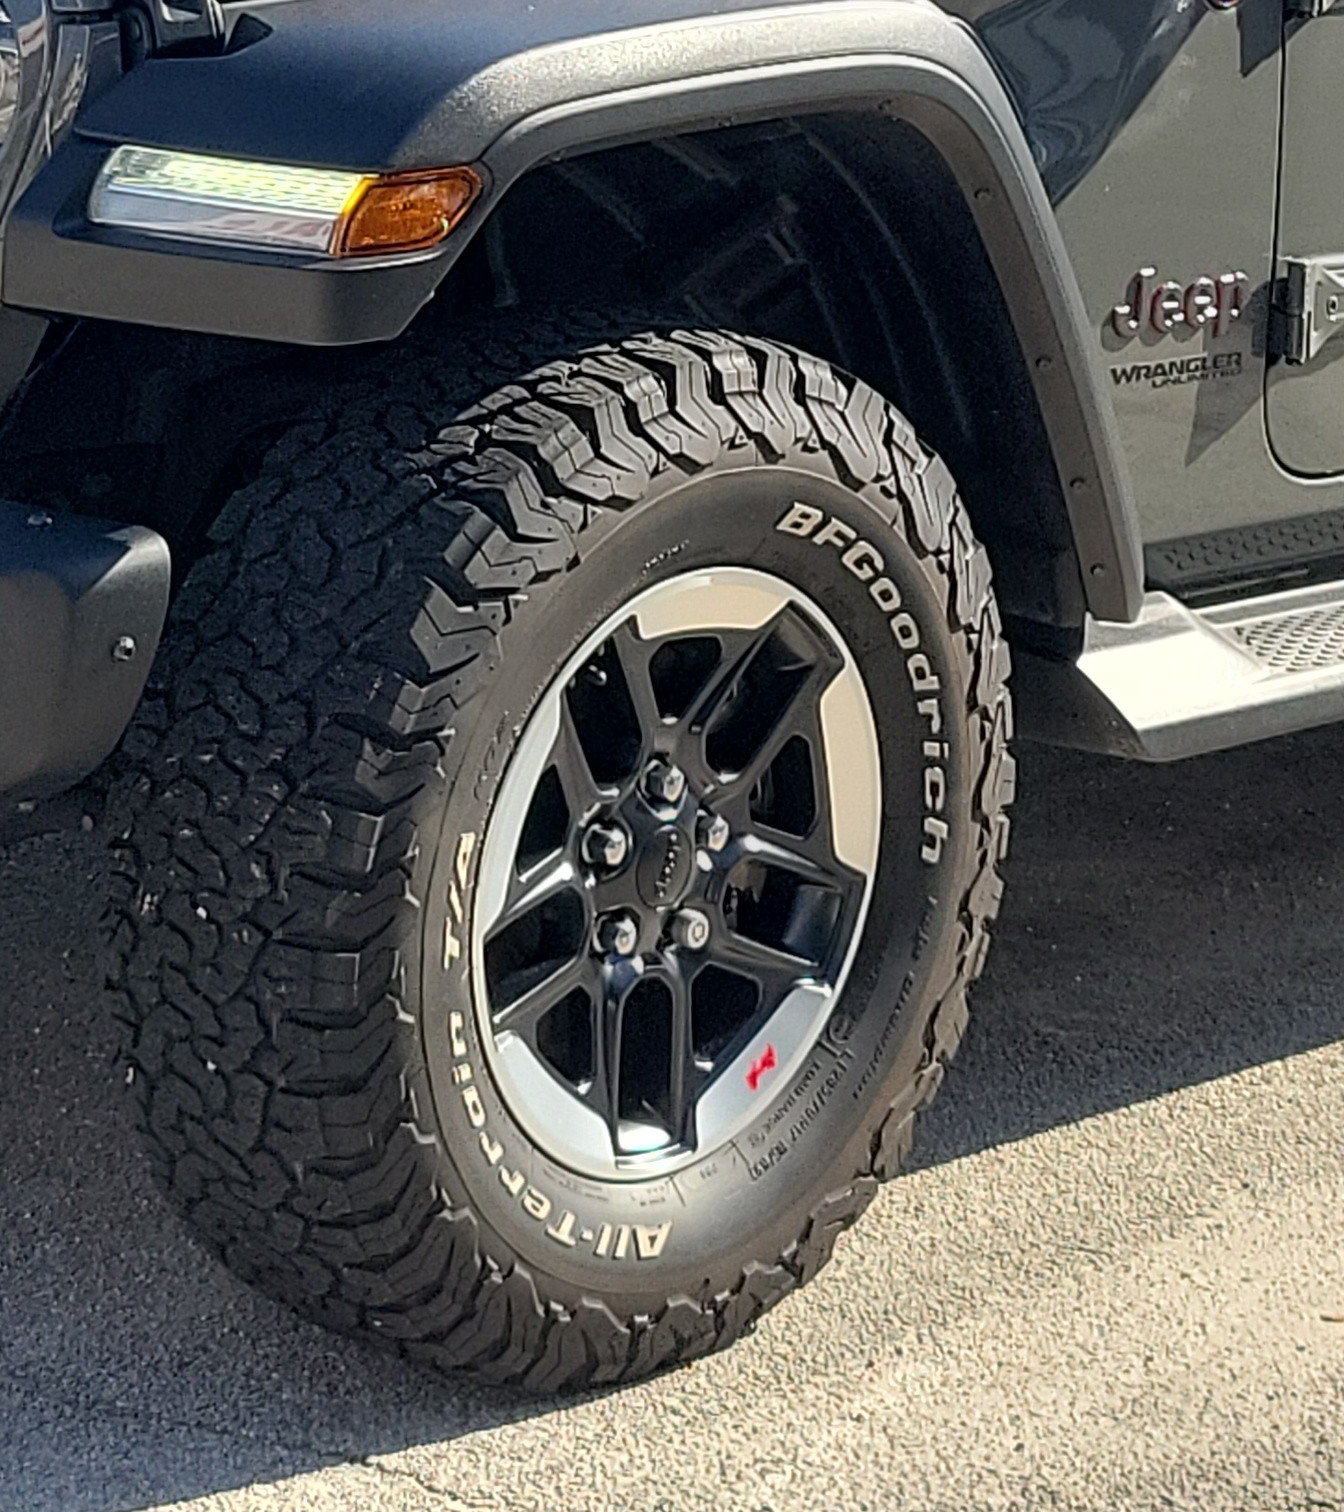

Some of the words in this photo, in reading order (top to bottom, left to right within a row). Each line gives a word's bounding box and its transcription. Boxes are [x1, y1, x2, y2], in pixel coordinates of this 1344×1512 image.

[1110, 265, 1249, 339] Jeep
[1110, 352, 1242, 386] WRANGLER
[1150, 368, 1243, 389] UNLIMITED
[775, 500, 950, 865] BFGoodrich
